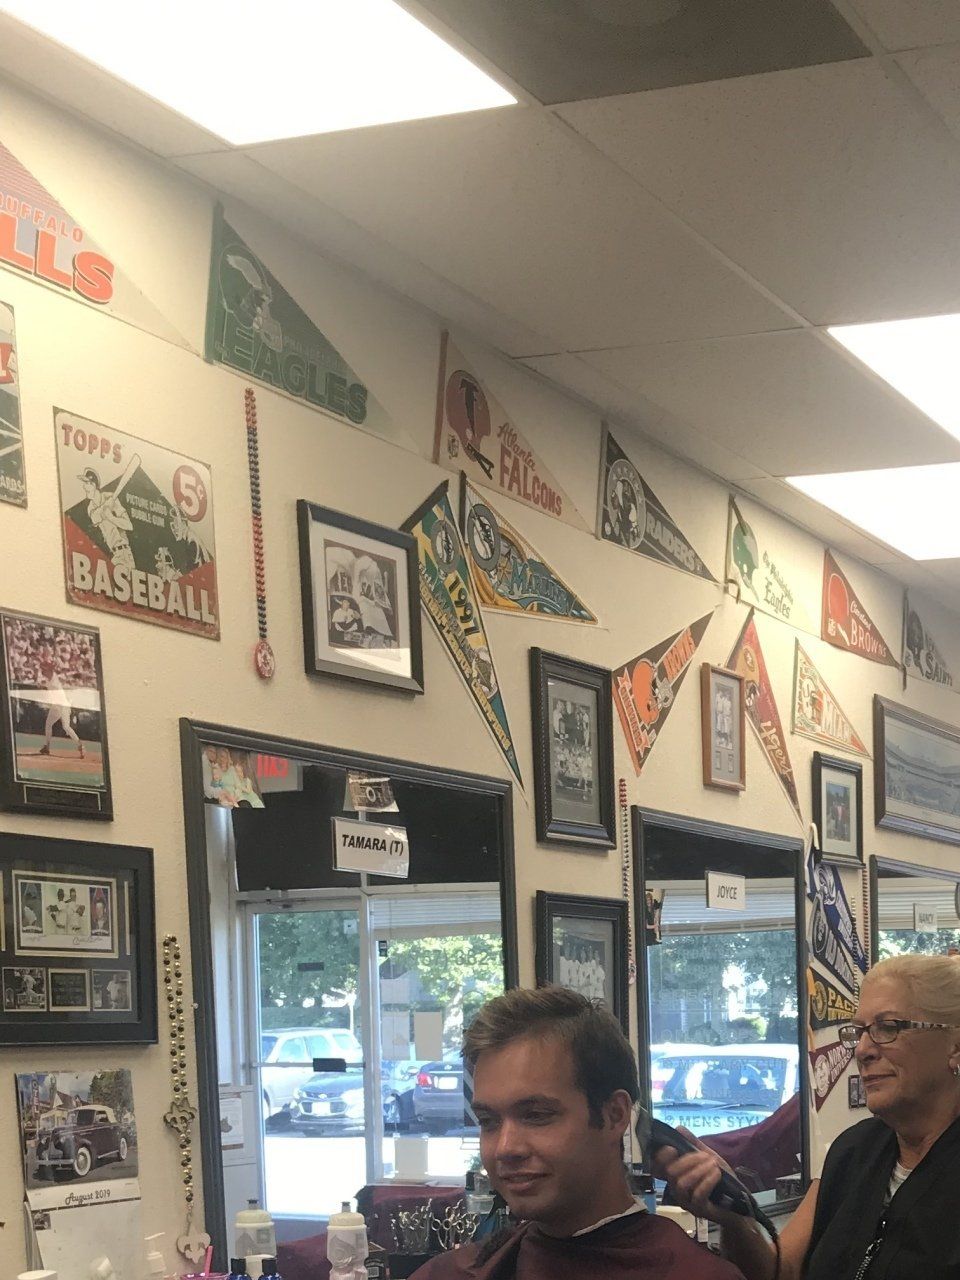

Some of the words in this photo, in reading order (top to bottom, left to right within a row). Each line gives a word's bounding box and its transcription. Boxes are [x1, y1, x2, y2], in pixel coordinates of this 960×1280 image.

[222, 312, 368, 424] EAGLES
[61, 423, 121, 464] TOPPS
[497, 422, 536, 472] Atlanta
[499, 444, 562, 516] FALCONS
[646, 512, 696, 571] RAIDERS
[72, 551, 215, 625] BASEBALL
[763, 578, 791, 619] Eagles
[851, 618, 887, 657] BROWNS
[760, 720, 793, 781] 49ers
[342, 834, 387, 852] TAMARA
[389, 839, 404, 857] (T)
[716, 885, 738, 900] JOYCE
[679, 1115, 722, 1129] MENS
[65, 1191, 93, 1206] August
[95, 1189, 111, 1200] 2019
